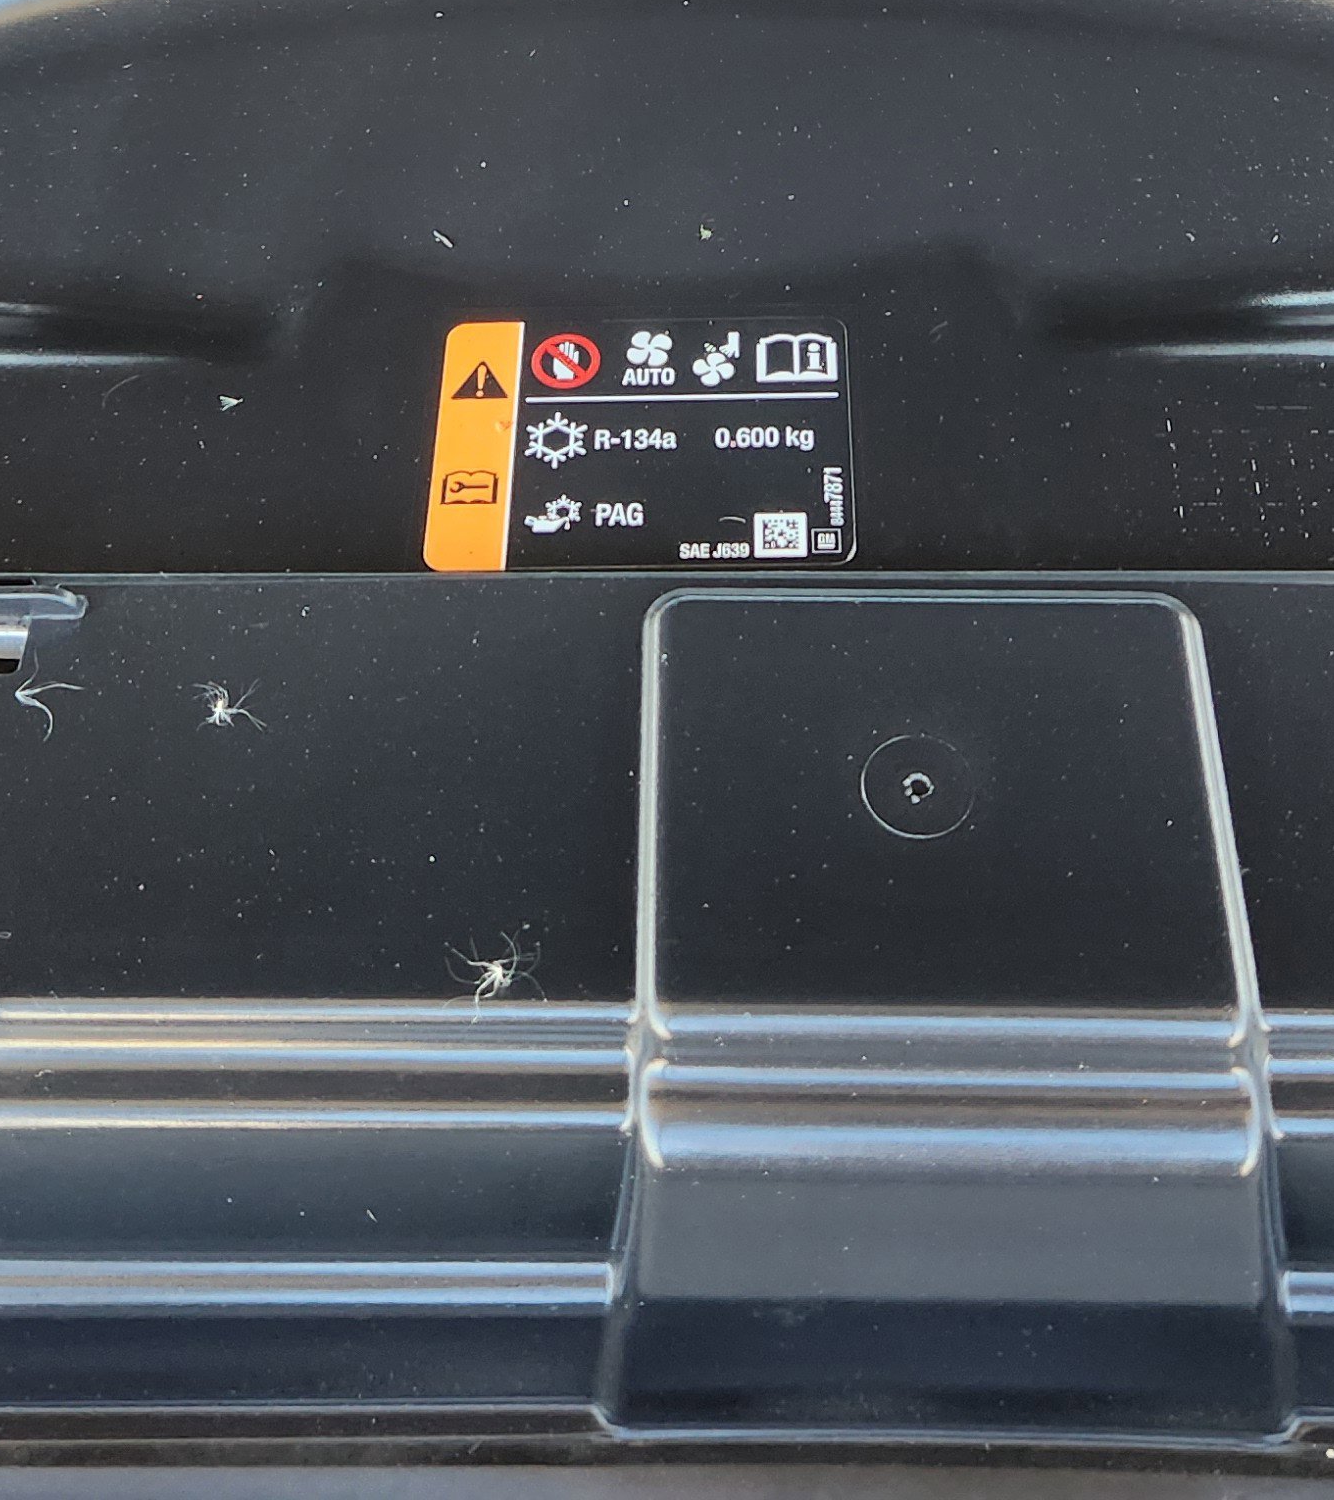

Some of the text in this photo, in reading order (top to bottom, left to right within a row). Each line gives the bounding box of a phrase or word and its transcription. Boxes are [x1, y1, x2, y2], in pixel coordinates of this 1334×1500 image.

[621, 367, 676, 387] AUTO
[593, 425, 816, 451] R-134a 0.600 kg
[594, 502, 645, 527] PAG
[679, 542, 751, 560] SAE J639
